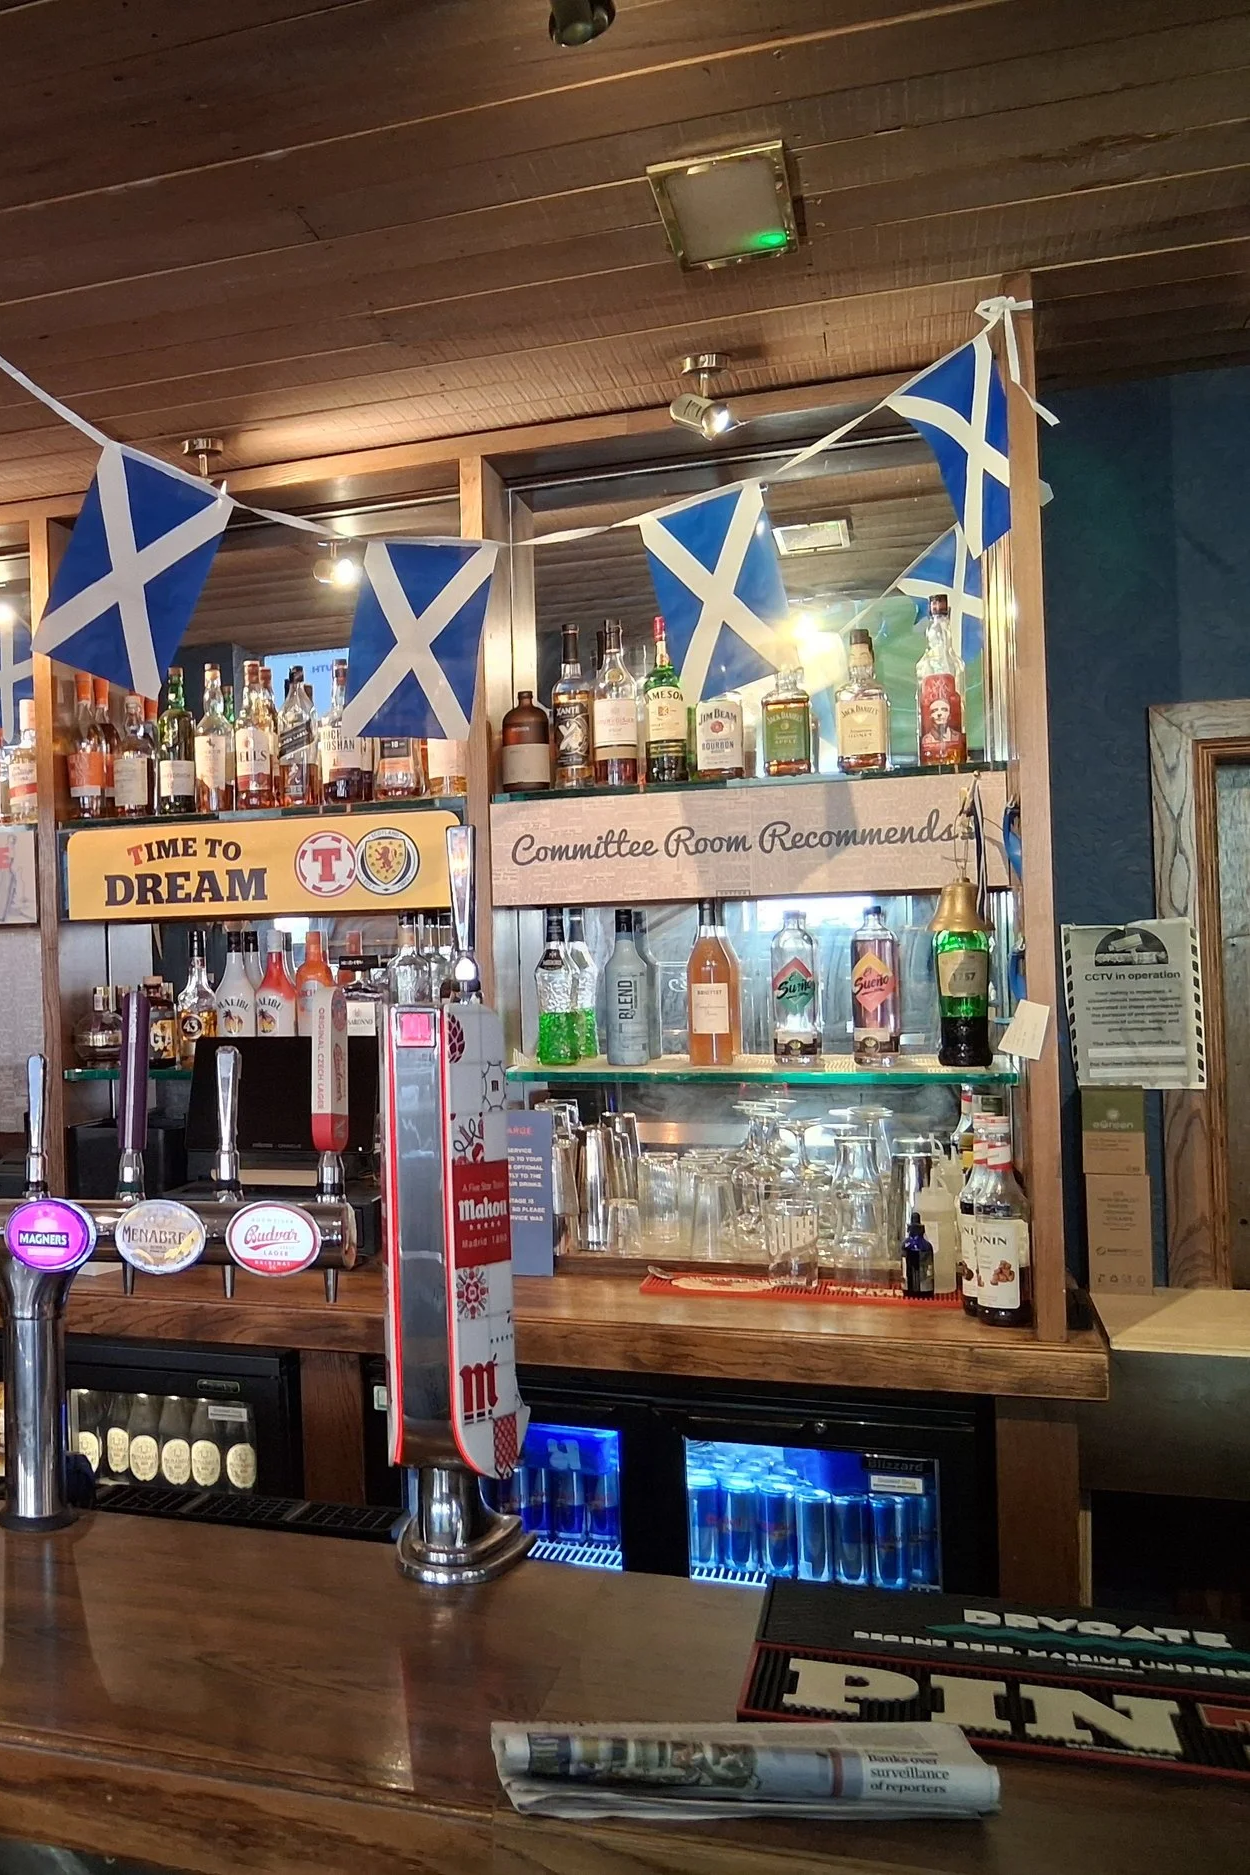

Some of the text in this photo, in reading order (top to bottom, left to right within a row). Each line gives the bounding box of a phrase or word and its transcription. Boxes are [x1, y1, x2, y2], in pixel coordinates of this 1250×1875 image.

[699, 708, 737, 726] JIM BEAM
[840, 708, 855, 719] JACK
[702, 741, 734, 751] BOURBON
[512, 808, 959, 867] Committee Room Recommends
[127, 837, 242, 867] TIME TO
[312, 848, 342, 882] T
[104, 867, 268, 907] DREAM
[1084, 970, 1181, 982] CCTV in operation
[854, 973, 890, 995] Sueño
[217, 997, 249, 1011] MALIBU
[258, 996, 283, 1011] ALIBU
[618, 980, 634, 1020] BLEND
[183, 1019, 196, 1031] 43
[317, 1007, 325, 1051] ORIGINAL
[317, 1052, 325, 1081] CZECH
[458, 1196, 508, 1221] Mahou
[19, 1233, 67, 1247] MAGNERS
[244, 1224, 299, 1245] Budvar
[976, 1234, 1007, 1245] ONIN
[462, 1237, 488, 1248] Madrid
[869, 1460, 924, 1472] Blizzard
[964, 1608, 1232, 1649] DRYGATE
[868, 1753, 938, 1766] Banks over
[870, 1766, 950, 1781] surveillance
[870, 1782, 947, 1794] of reporters
